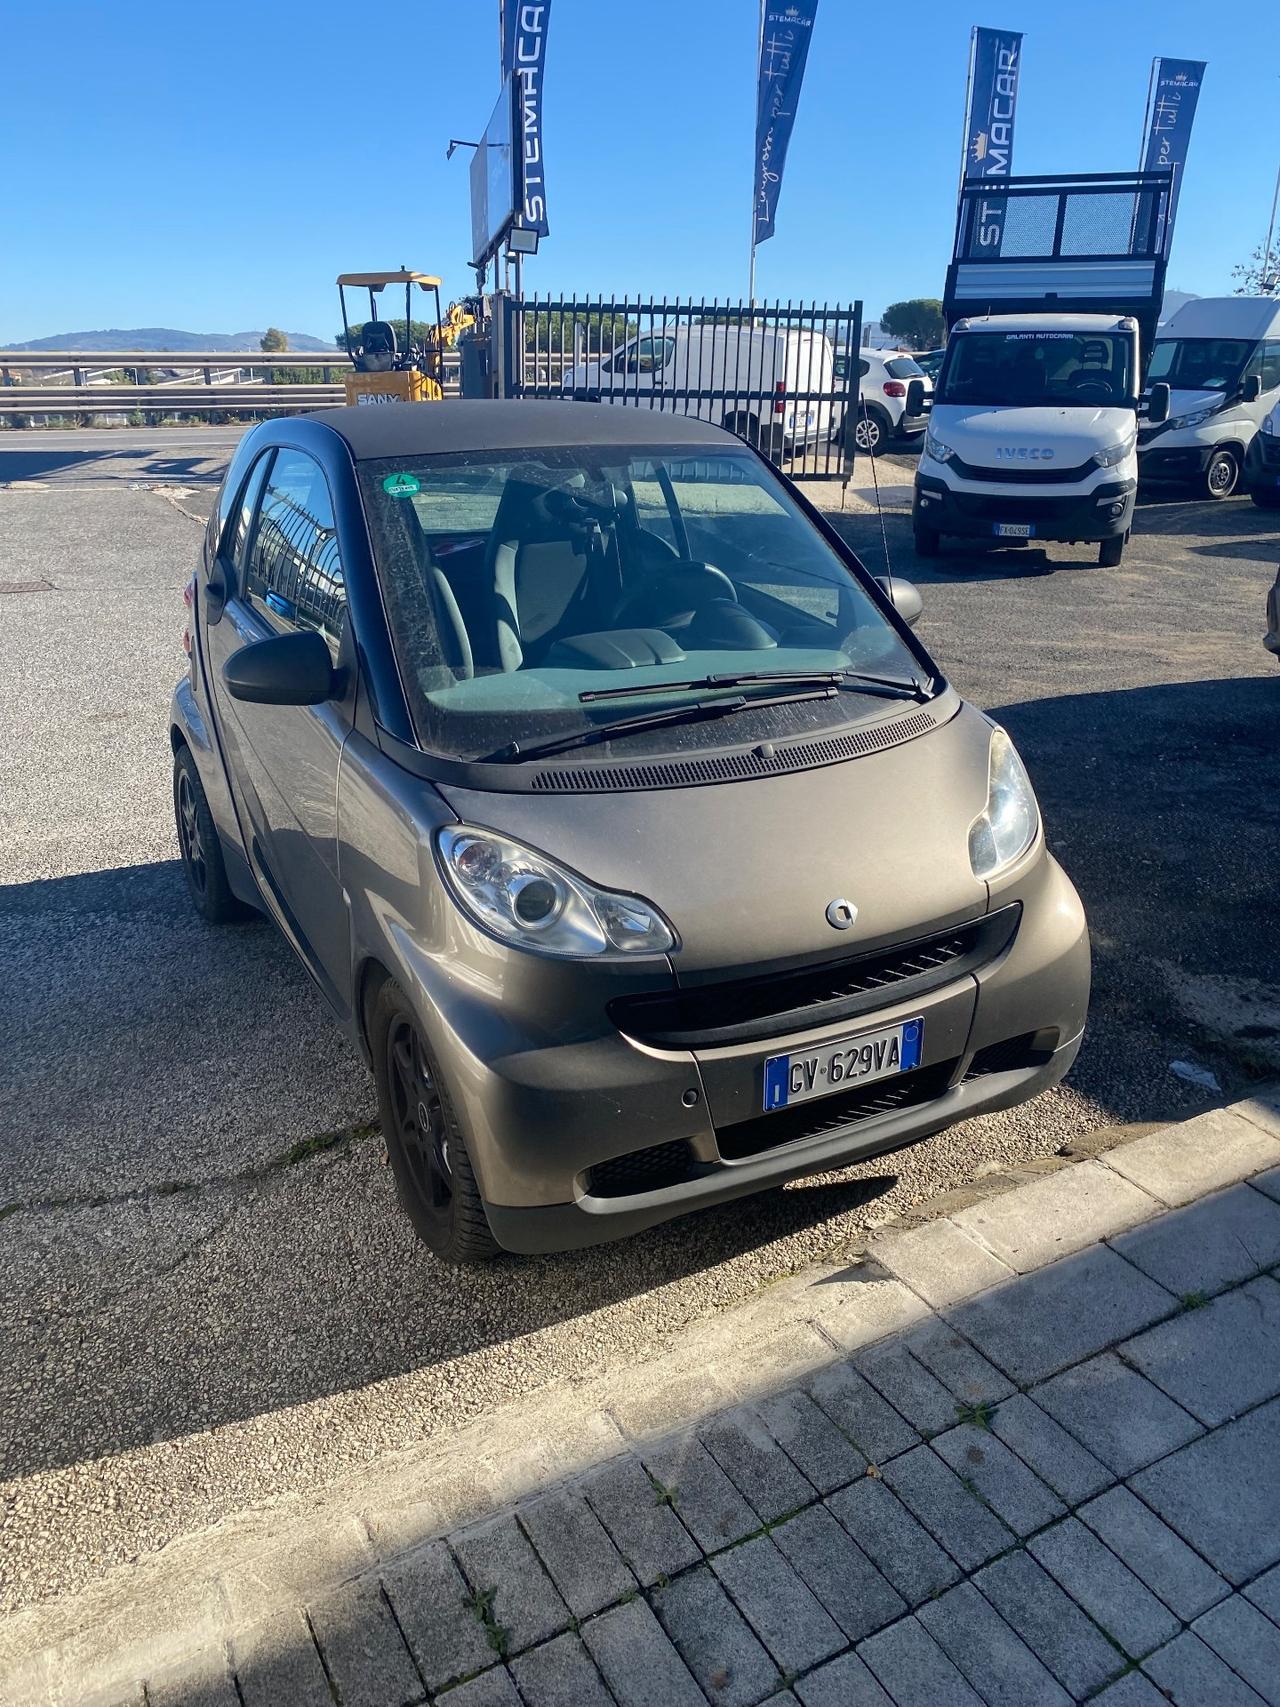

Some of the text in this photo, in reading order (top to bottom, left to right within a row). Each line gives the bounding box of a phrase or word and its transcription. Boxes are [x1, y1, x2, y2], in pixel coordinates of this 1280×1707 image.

[516, 0, 545, 222] STEMACA
[979, 40, 1018, 247] STMACAR
[357, 393, 400, 405] SANY
[995, 447, 1055, 460] IVECO
[789, 1056, 819, 1095] GV
[830, 1036, 901, 1083] 629VA
